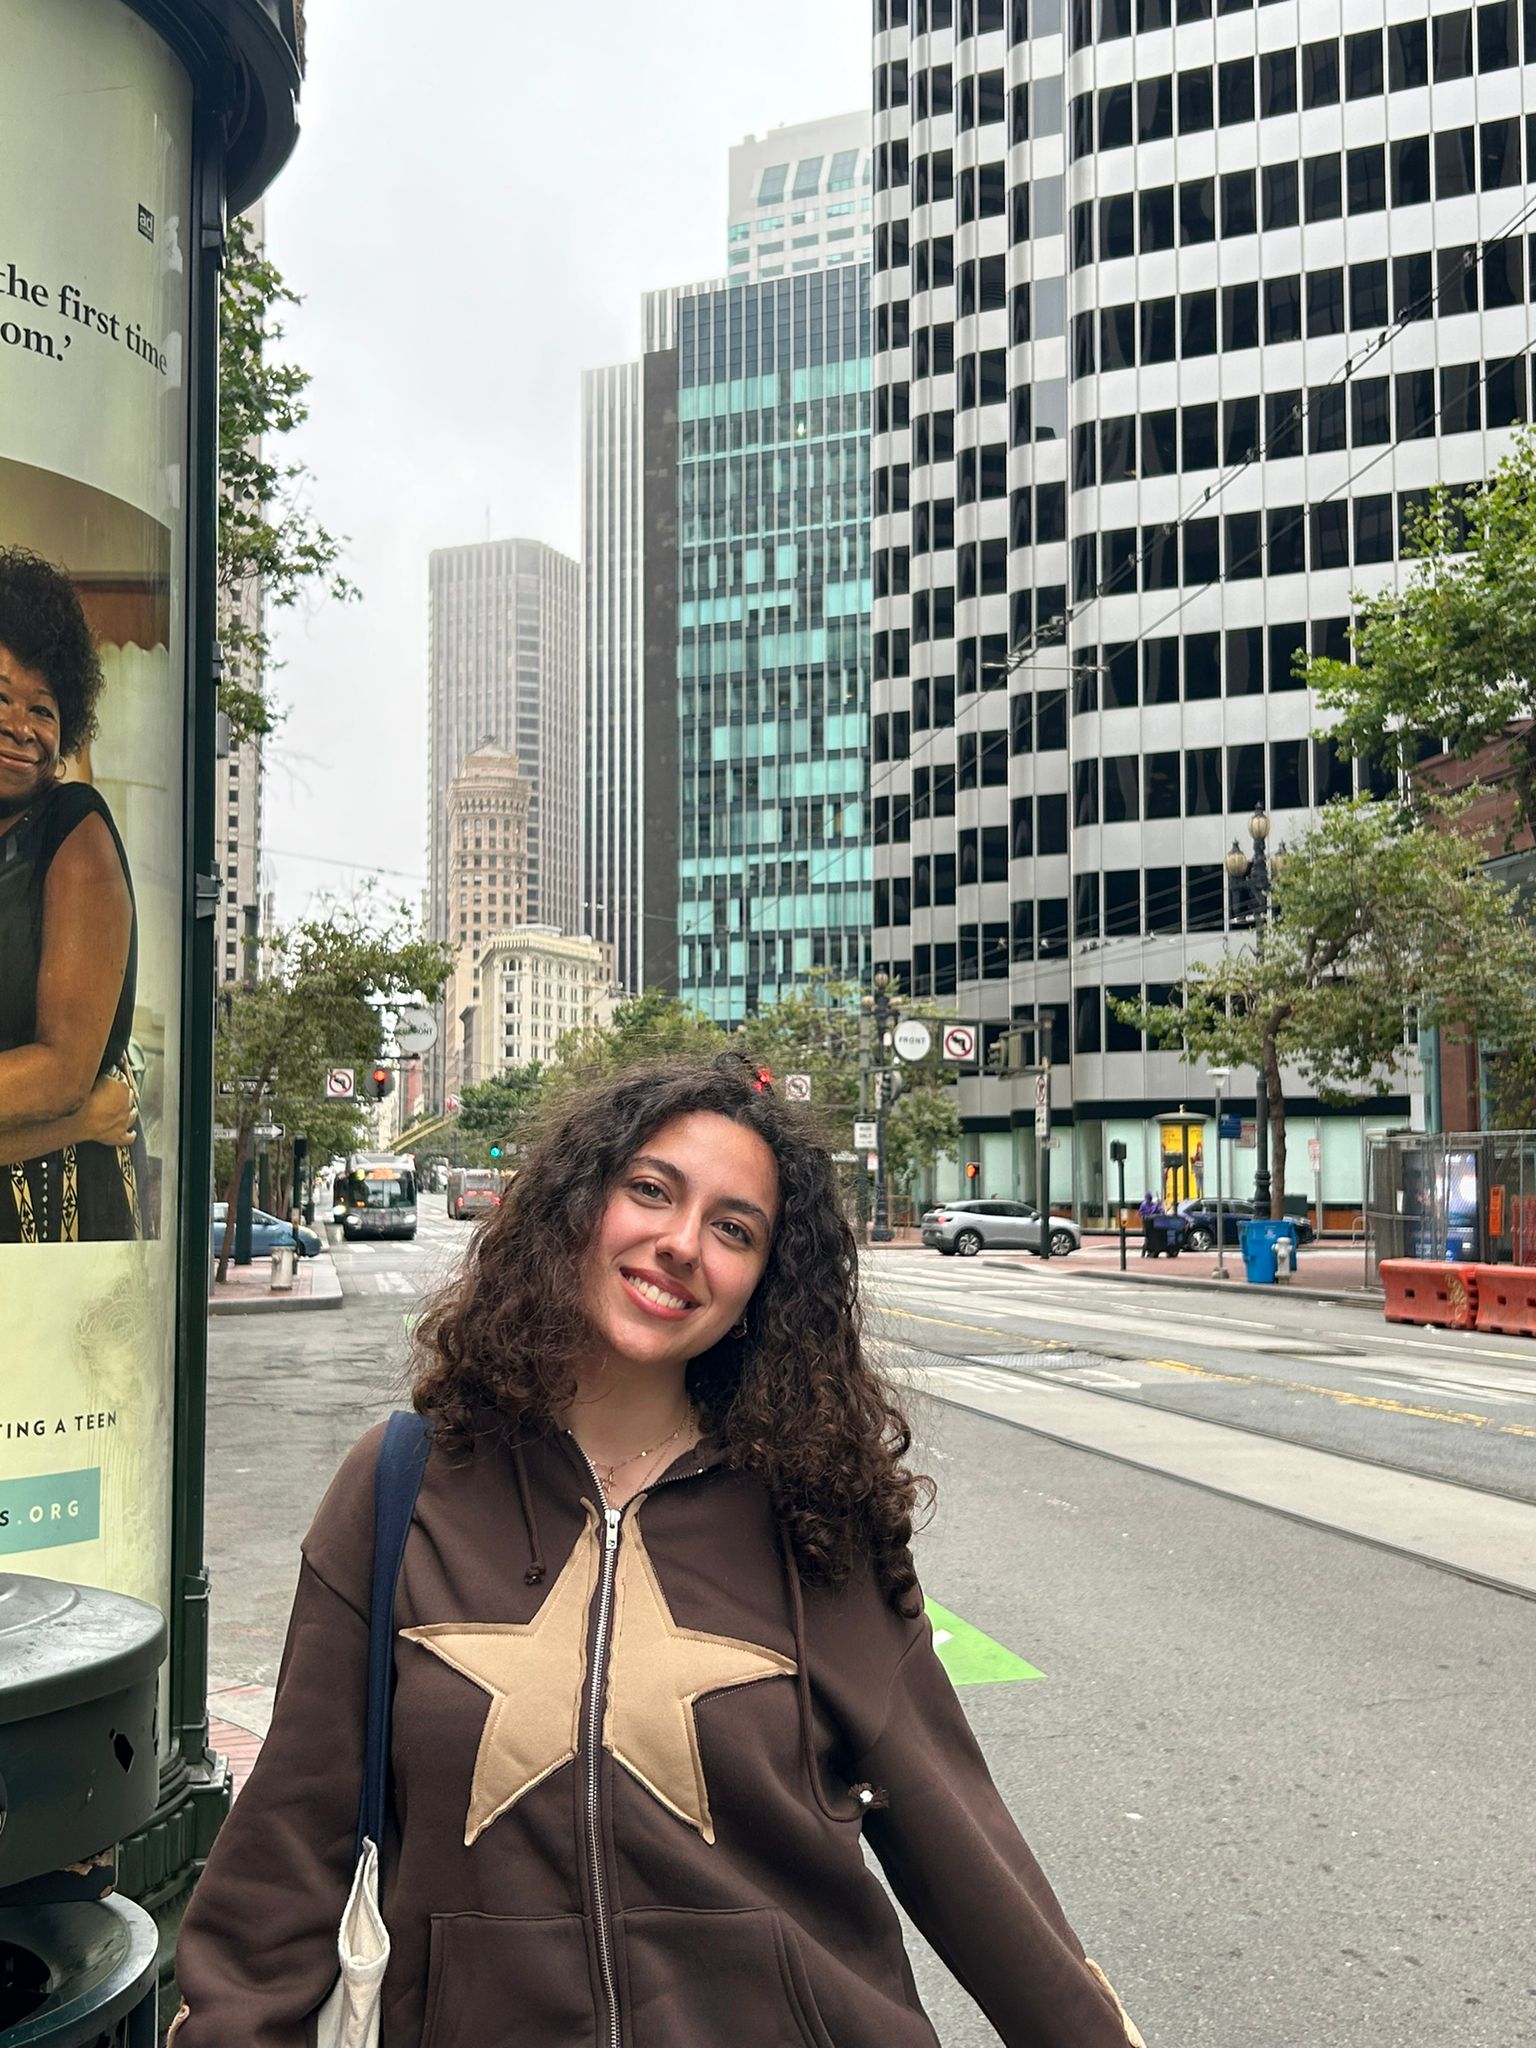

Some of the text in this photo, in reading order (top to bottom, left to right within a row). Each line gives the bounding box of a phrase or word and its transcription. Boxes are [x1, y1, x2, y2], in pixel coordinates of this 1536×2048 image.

[0, 263, 167, 376] he first time
[0, 1411, 117, 1439] ING A TEEN
